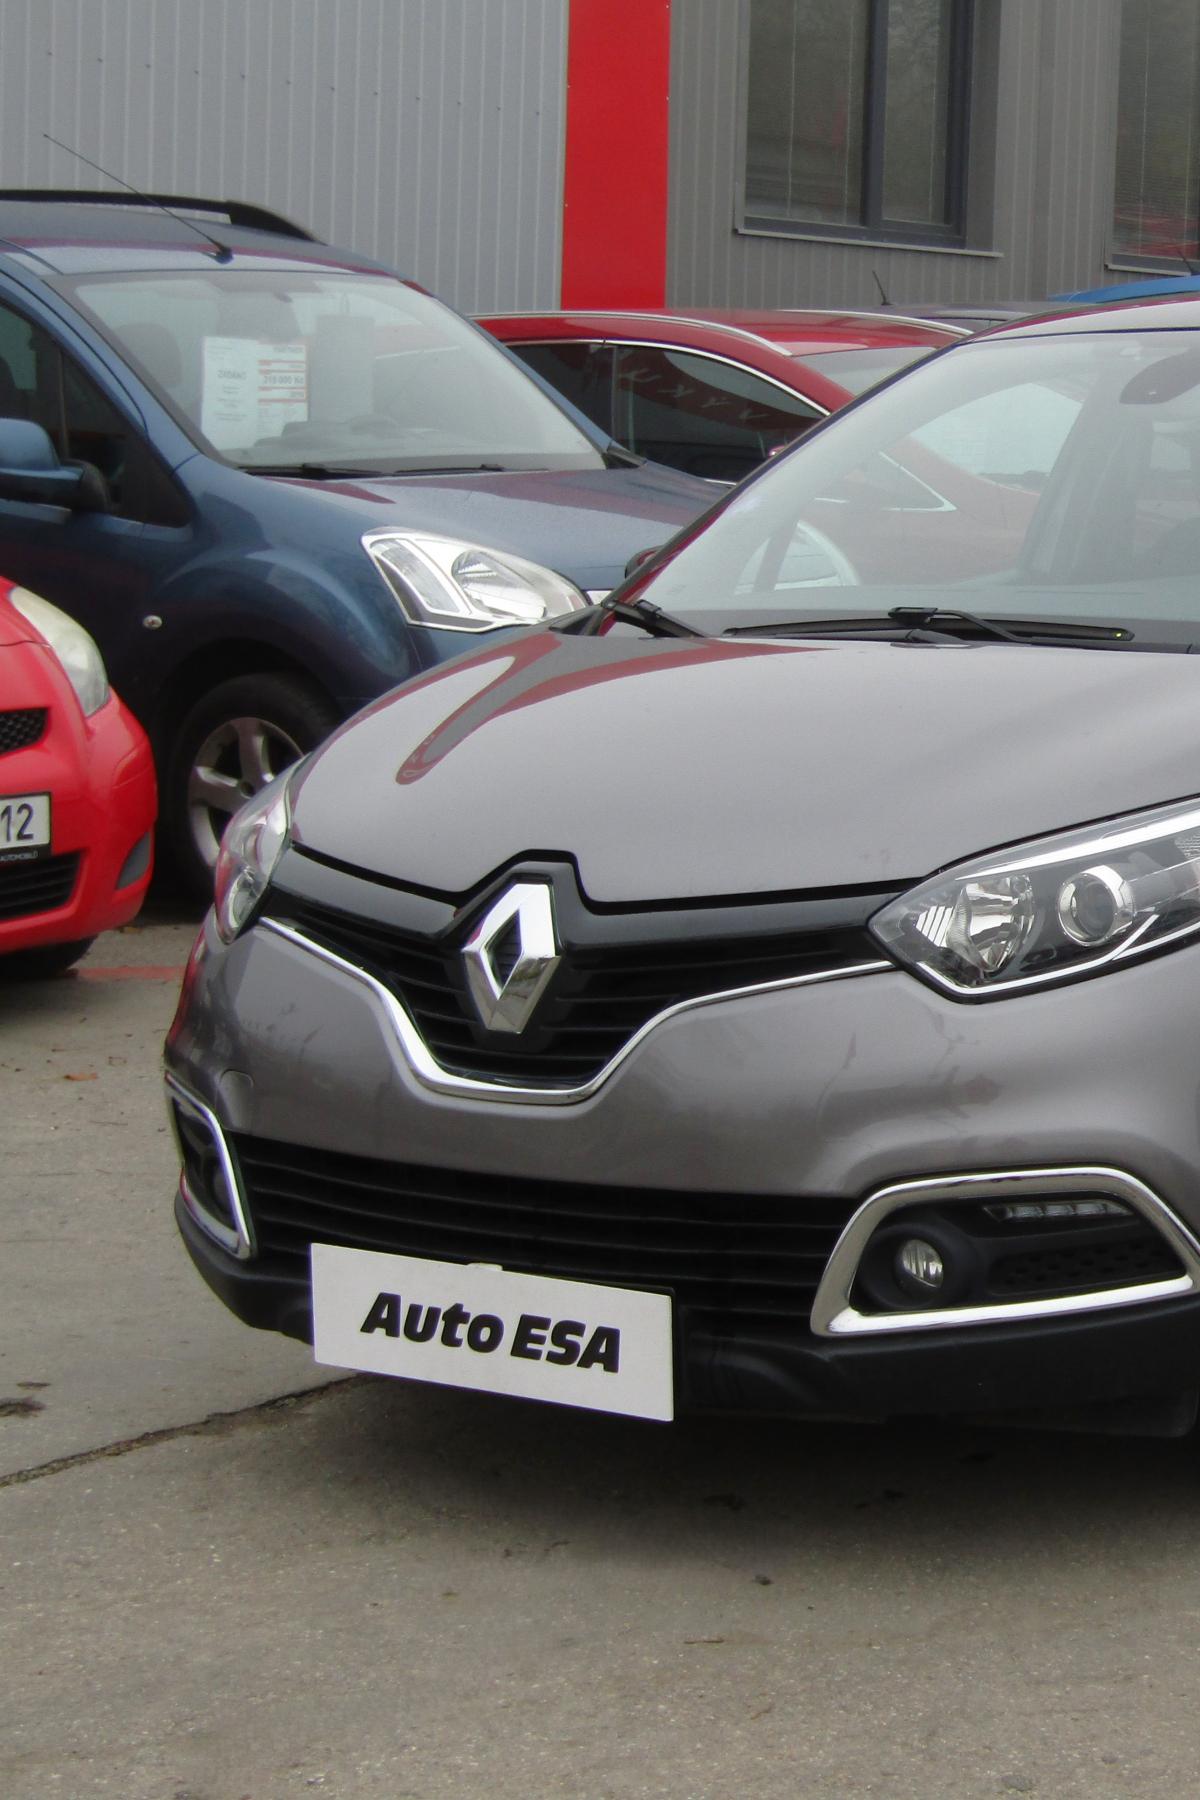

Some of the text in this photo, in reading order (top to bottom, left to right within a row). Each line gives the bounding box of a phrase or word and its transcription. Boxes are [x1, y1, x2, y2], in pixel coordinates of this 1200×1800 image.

[1, 803, 34, 842] 12
[360, 1292, 621, 1374] Auto ESA
